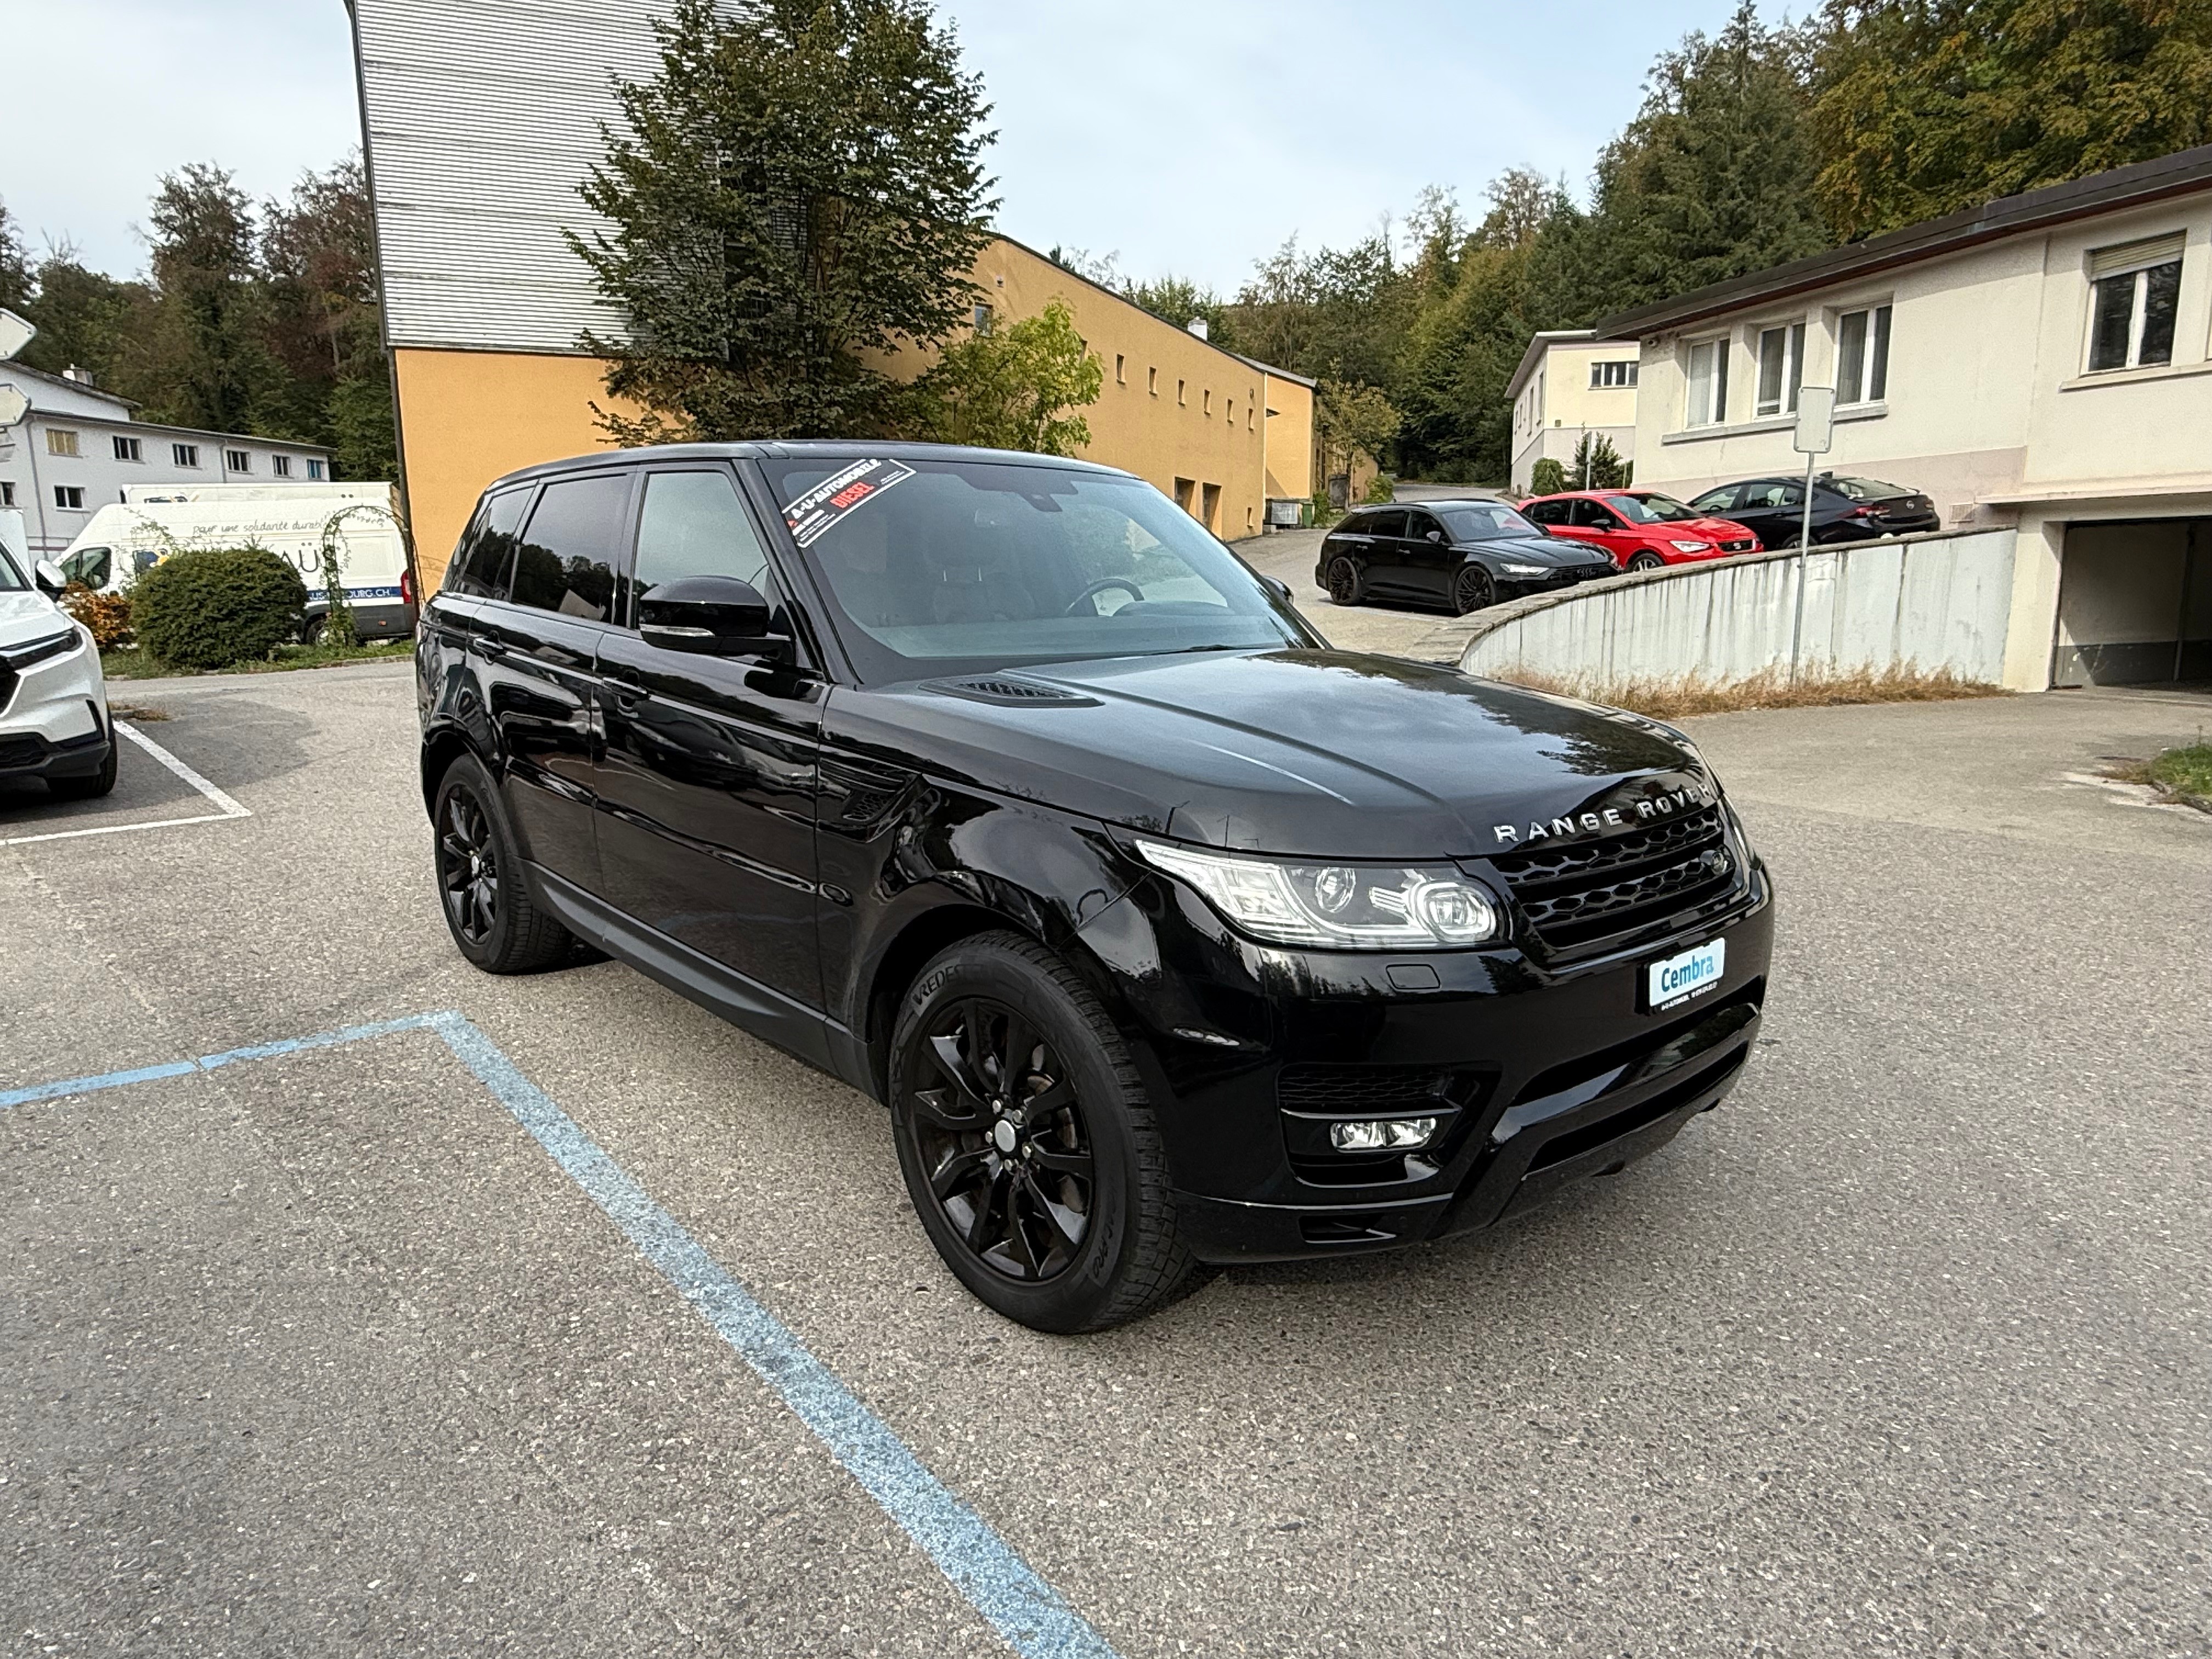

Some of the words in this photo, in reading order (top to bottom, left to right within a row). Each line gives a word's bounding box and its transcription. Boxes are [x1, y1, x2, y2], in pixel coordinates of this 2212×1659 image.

[830, 481, 876, 509] DIESEL
[193, 524, 218, 535] pour
[1493, 808, 1623, 844] RANGE
[1636, 783, 1712, 819] ROVER
[1661, 955, 1714, 992] Cembra
